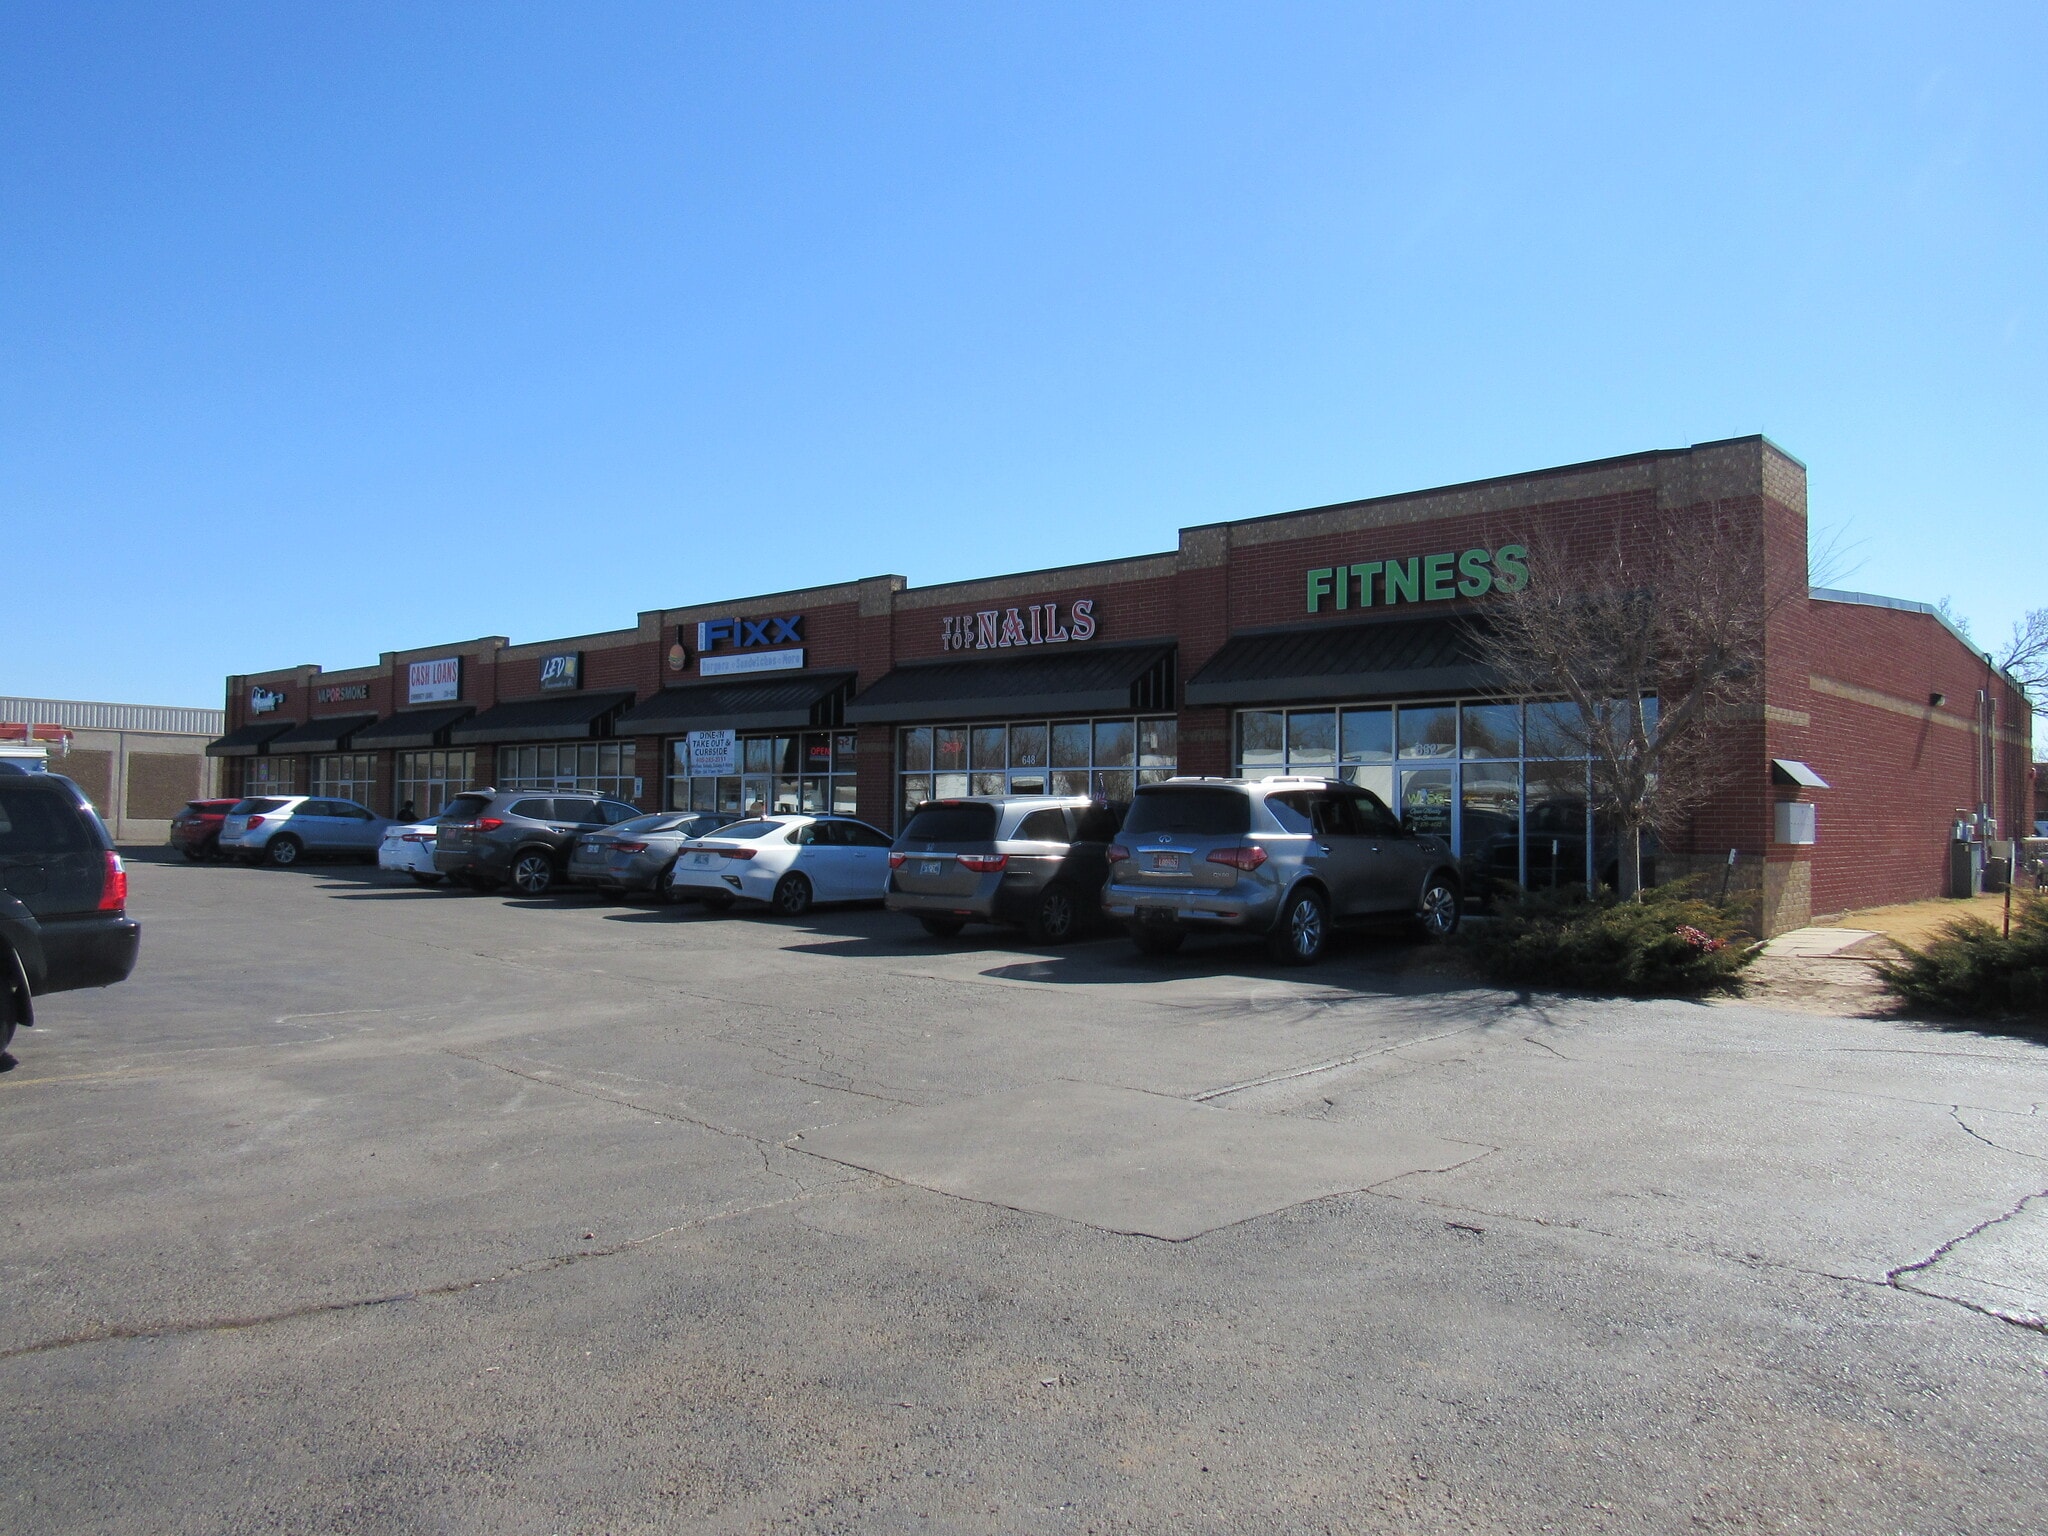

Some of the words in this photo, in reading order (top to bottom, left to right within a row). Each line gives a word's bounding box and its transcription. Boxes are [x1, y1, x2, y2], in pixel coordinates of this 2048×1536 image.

[1306, 544, 1529, 613] FITNESS
[943, 615, 973, 634] TIP
[976, 600, 1096, 650] NAILS
[941, 632, 975, 651] TOP
[411, 664, 430, 687] CASH
[433, 661, 457, 684] LOANS
[692, 740, 710, 748] TAKE
[710, 739, 724, 747] OUT
[724, 739, 731, 747] &
[695, 747, 728, 756] CURBSIDE
[810, 747, 831, 756] OPEN
[1021, 755, 1036, 765] 648
